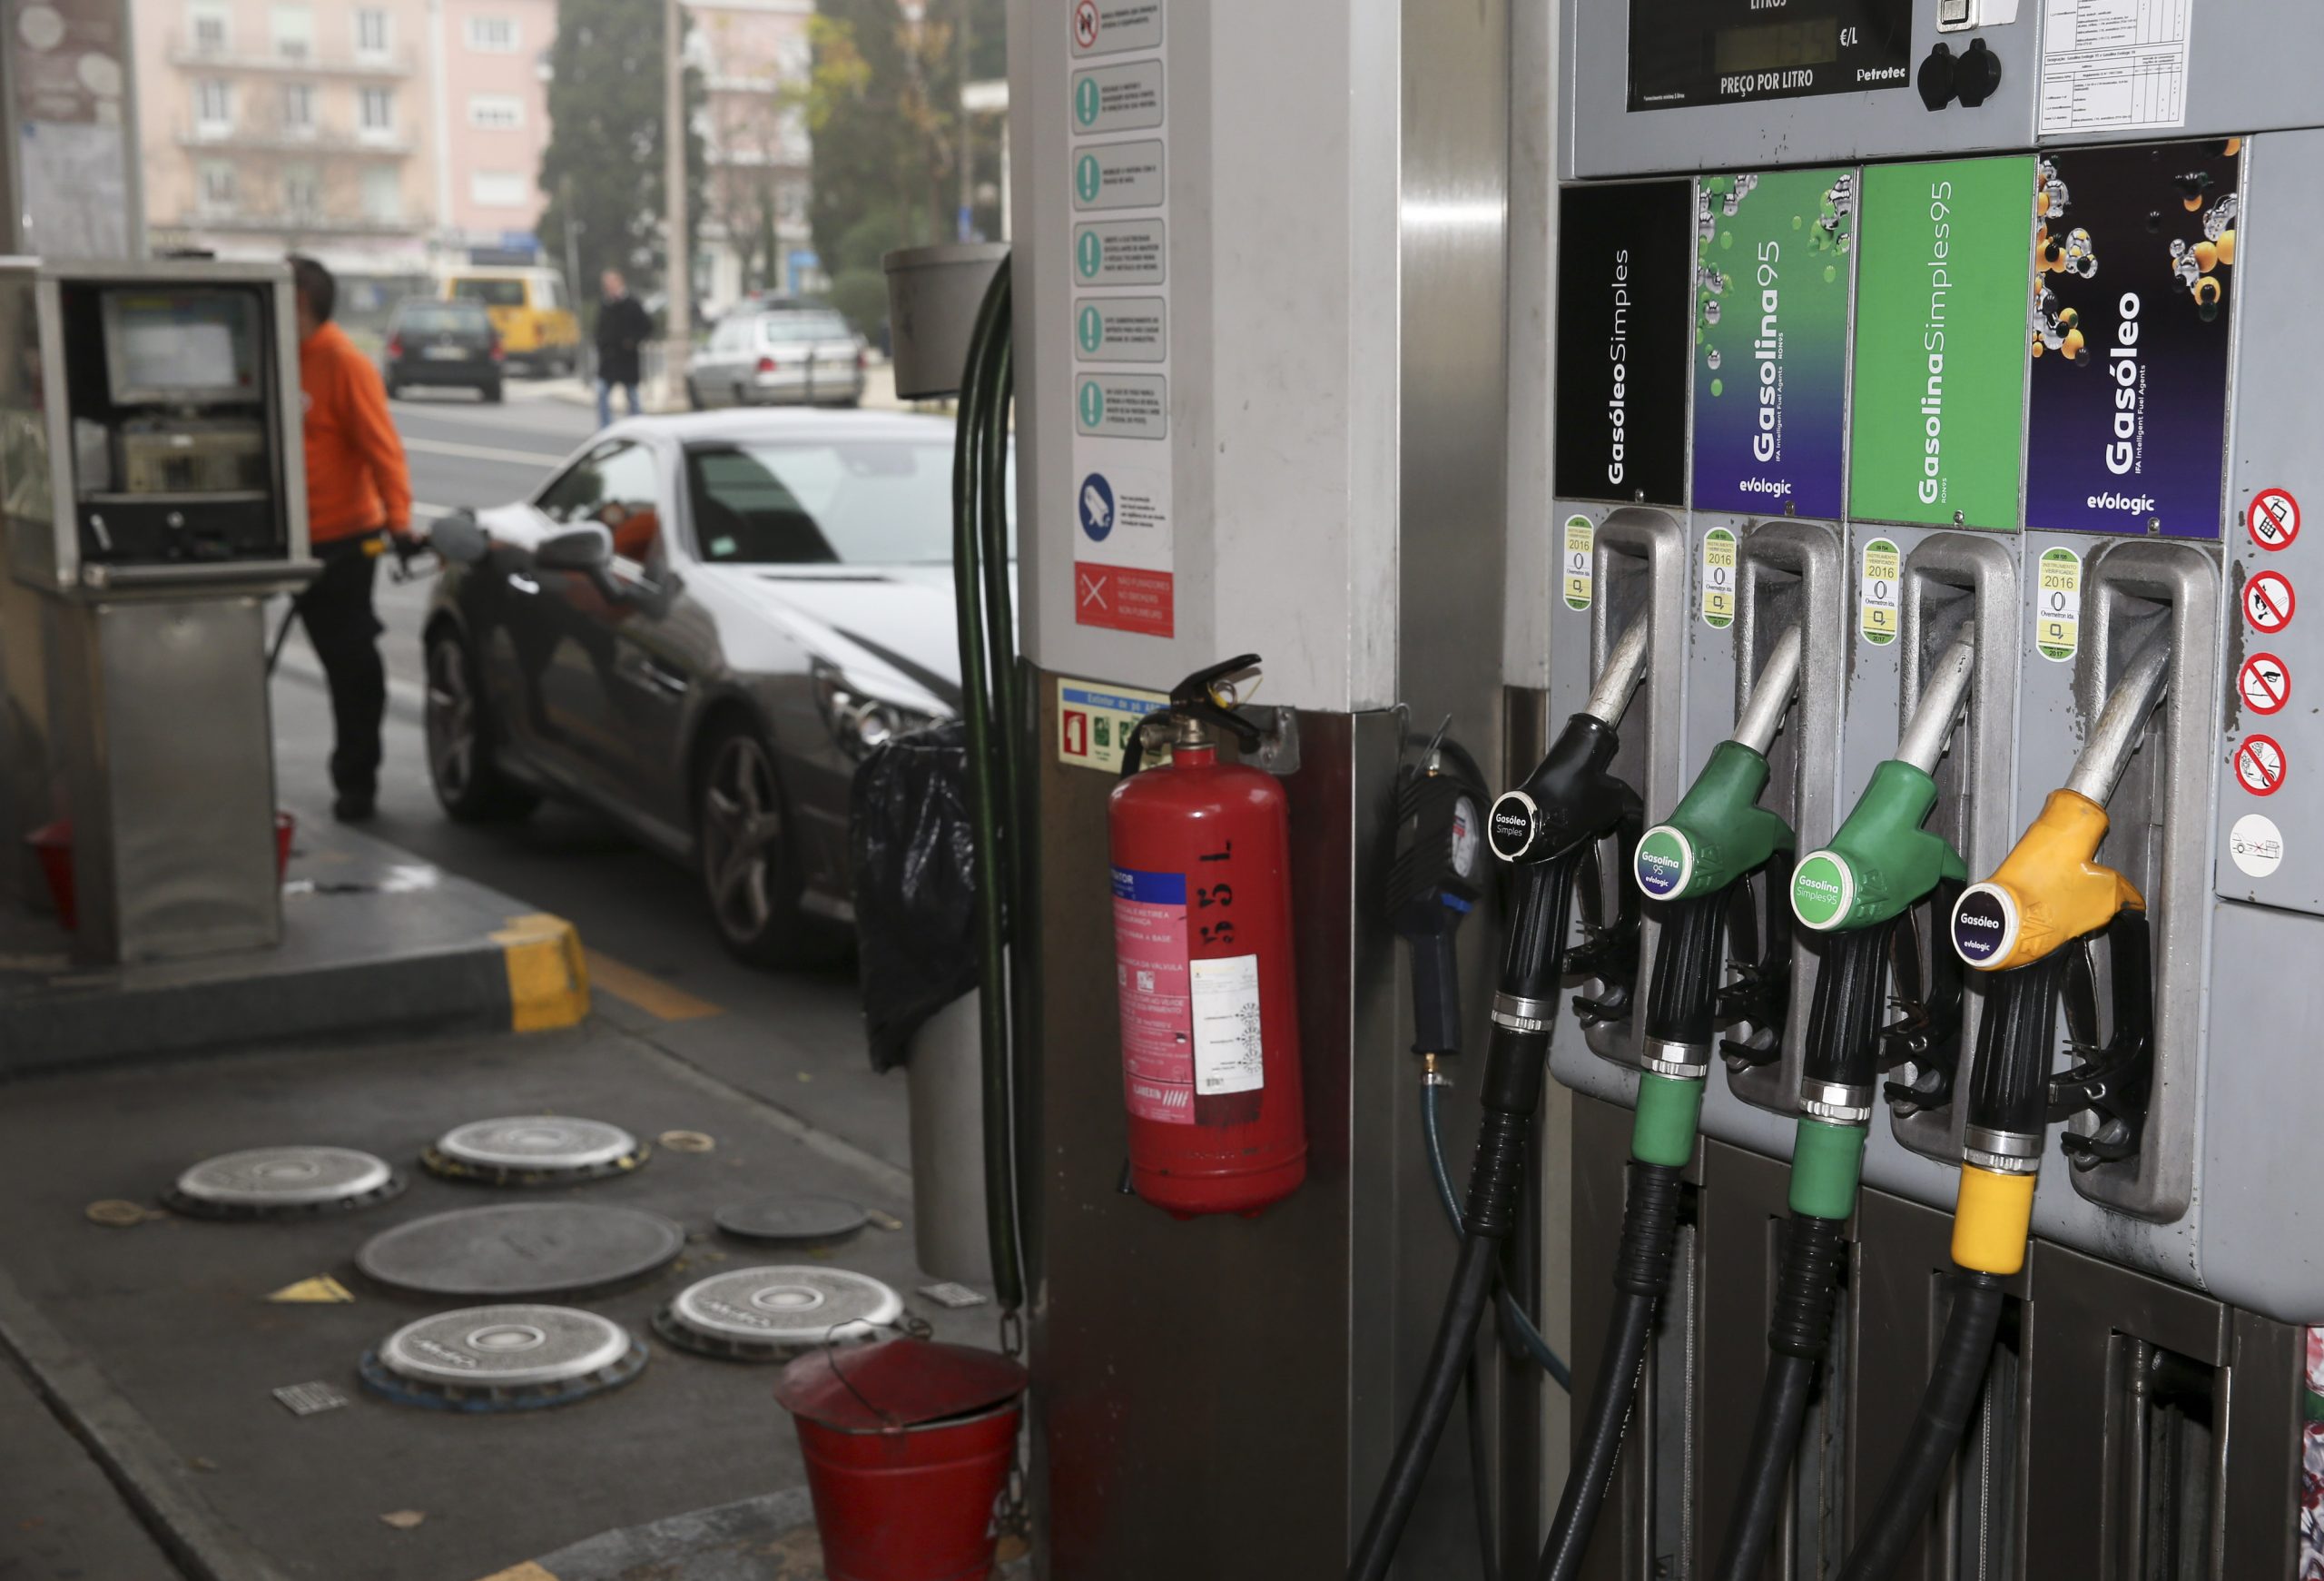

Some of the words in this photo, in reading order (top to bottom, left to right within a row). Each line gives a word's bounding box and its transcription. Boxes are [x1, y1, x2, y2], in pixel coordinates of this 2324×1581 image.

[1839, 27, 1858, 46] €/L
[1856, 67, 1905, 81] Petrotec
[1721, 75, 1755, 97] PREÇO
[1757, 73, 1779, 90] POR
[1782, 69, 1814, 88] LITRO
[2105, 292, 2140, 475] Gasóleo
[2138, 365, 2146, 395] Agents
[2136, 416, 2144, 459] Intelligent
[1739, 477, 1792, 499] evologic
[2086, 492, 2155, 515] evologic
[1569, 539, 1590, 551] 2016
[1709, 553, 1731, 565] 2016
[1868, 566, 1895, 578] 2016
[2044, 575, 2074, 589] 2016
[1495, 814, 1526, 827] Gasóleo
[1496, 825, 1523, 836] Simples
[1641, 851, 1679, 869] Gasolina
[1652, 864, 1664, 875] 95
[1798, 874, 1839, 894] Gasolina
[1960, 913, 2000, 929] Gasóleo
